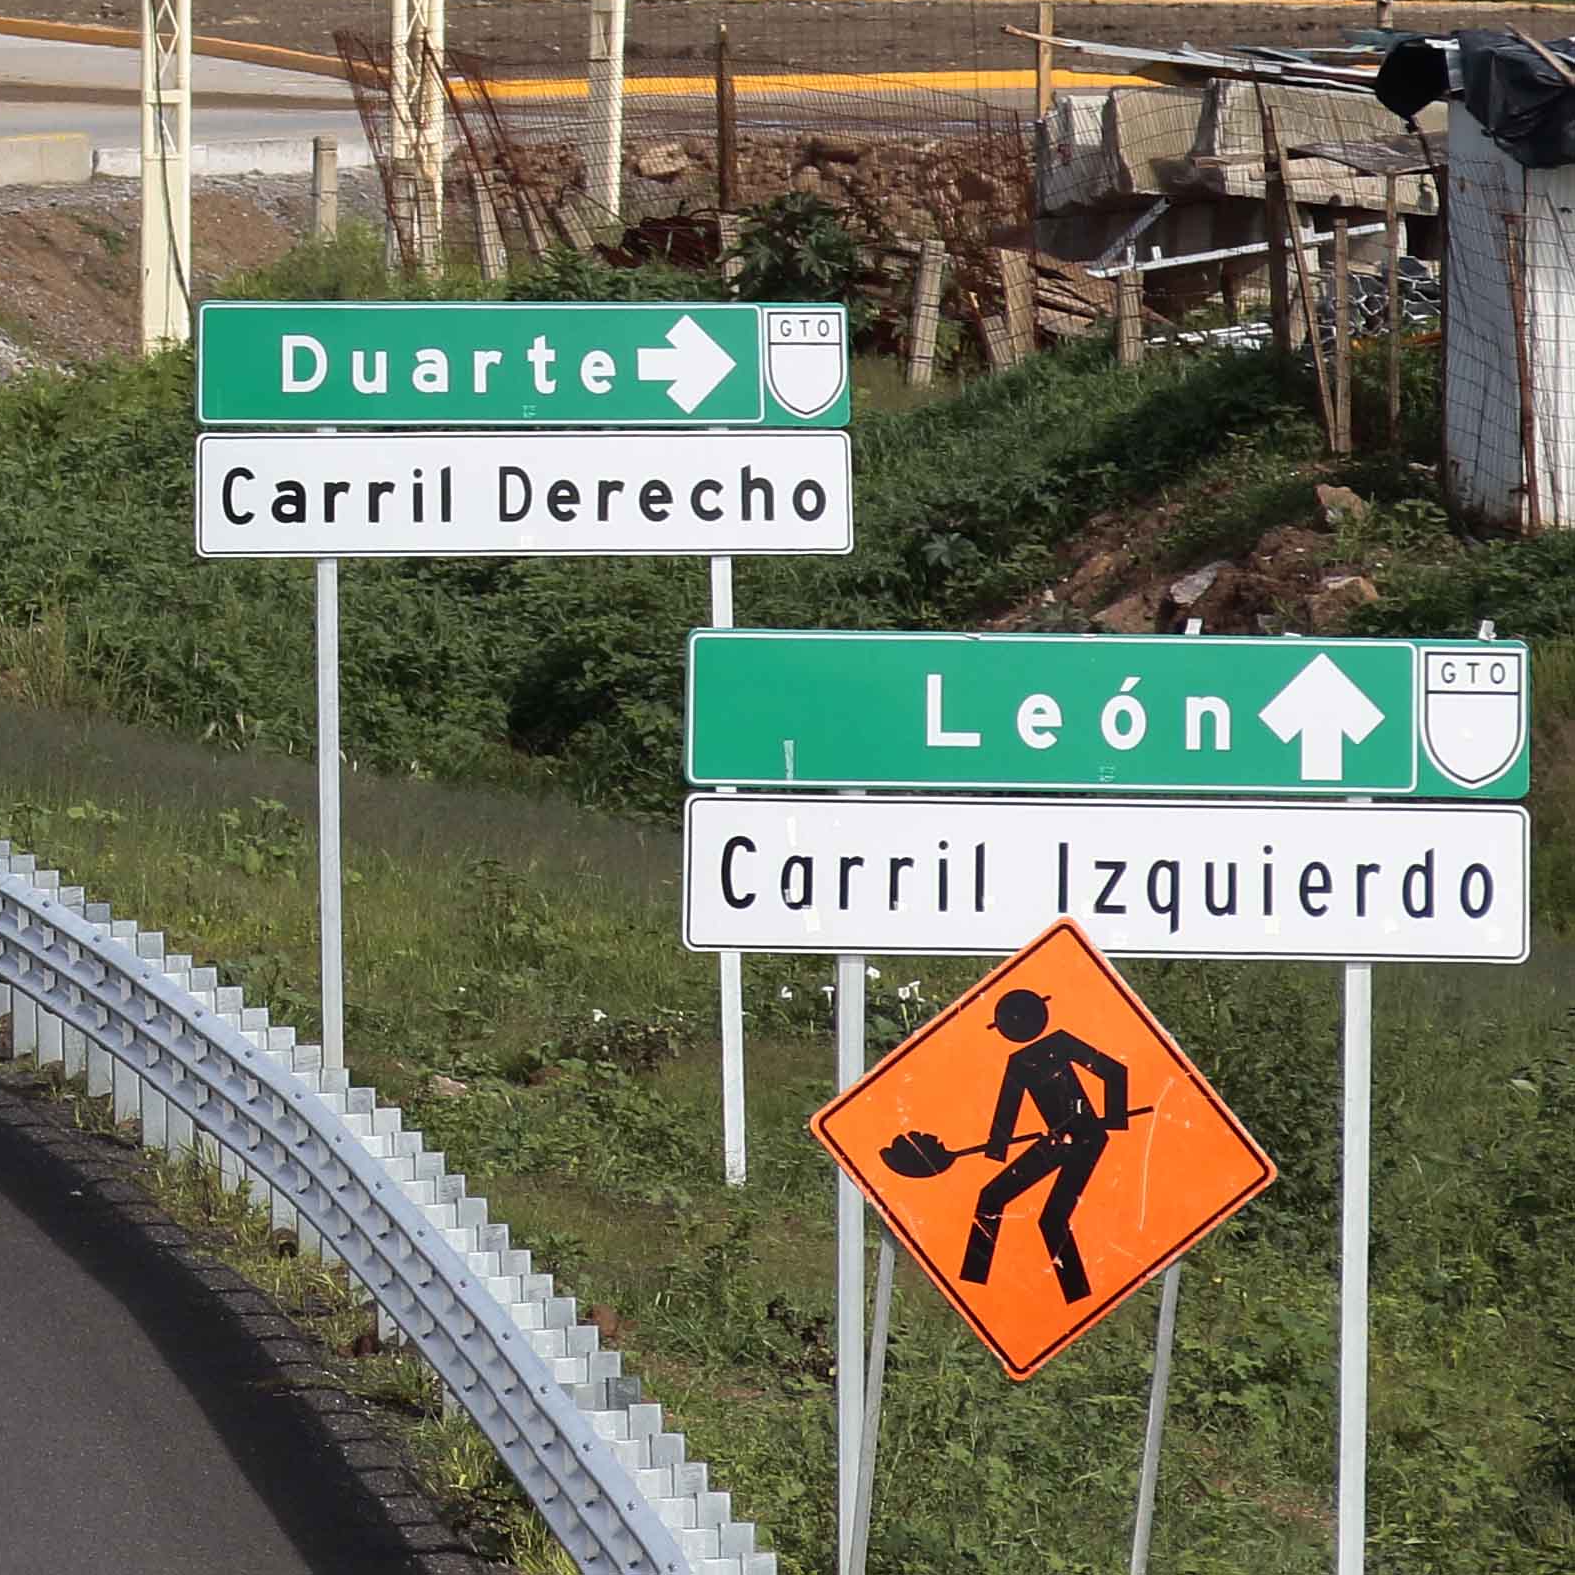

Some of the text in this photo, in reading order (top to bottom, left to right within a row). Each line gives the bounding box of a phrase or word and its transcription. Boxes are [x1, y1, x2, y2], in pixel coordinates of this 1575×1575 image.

[780, 319, 830, 337] GTO
[282, 334, 617, 394] Duarte
[222, 465, 827, 525] Carril Derecho
[1441, 661, 1506, 685] GTO
[927, 674, 1232, 752] León
[720, 835, 1495, 934] Carril Izquierdo
